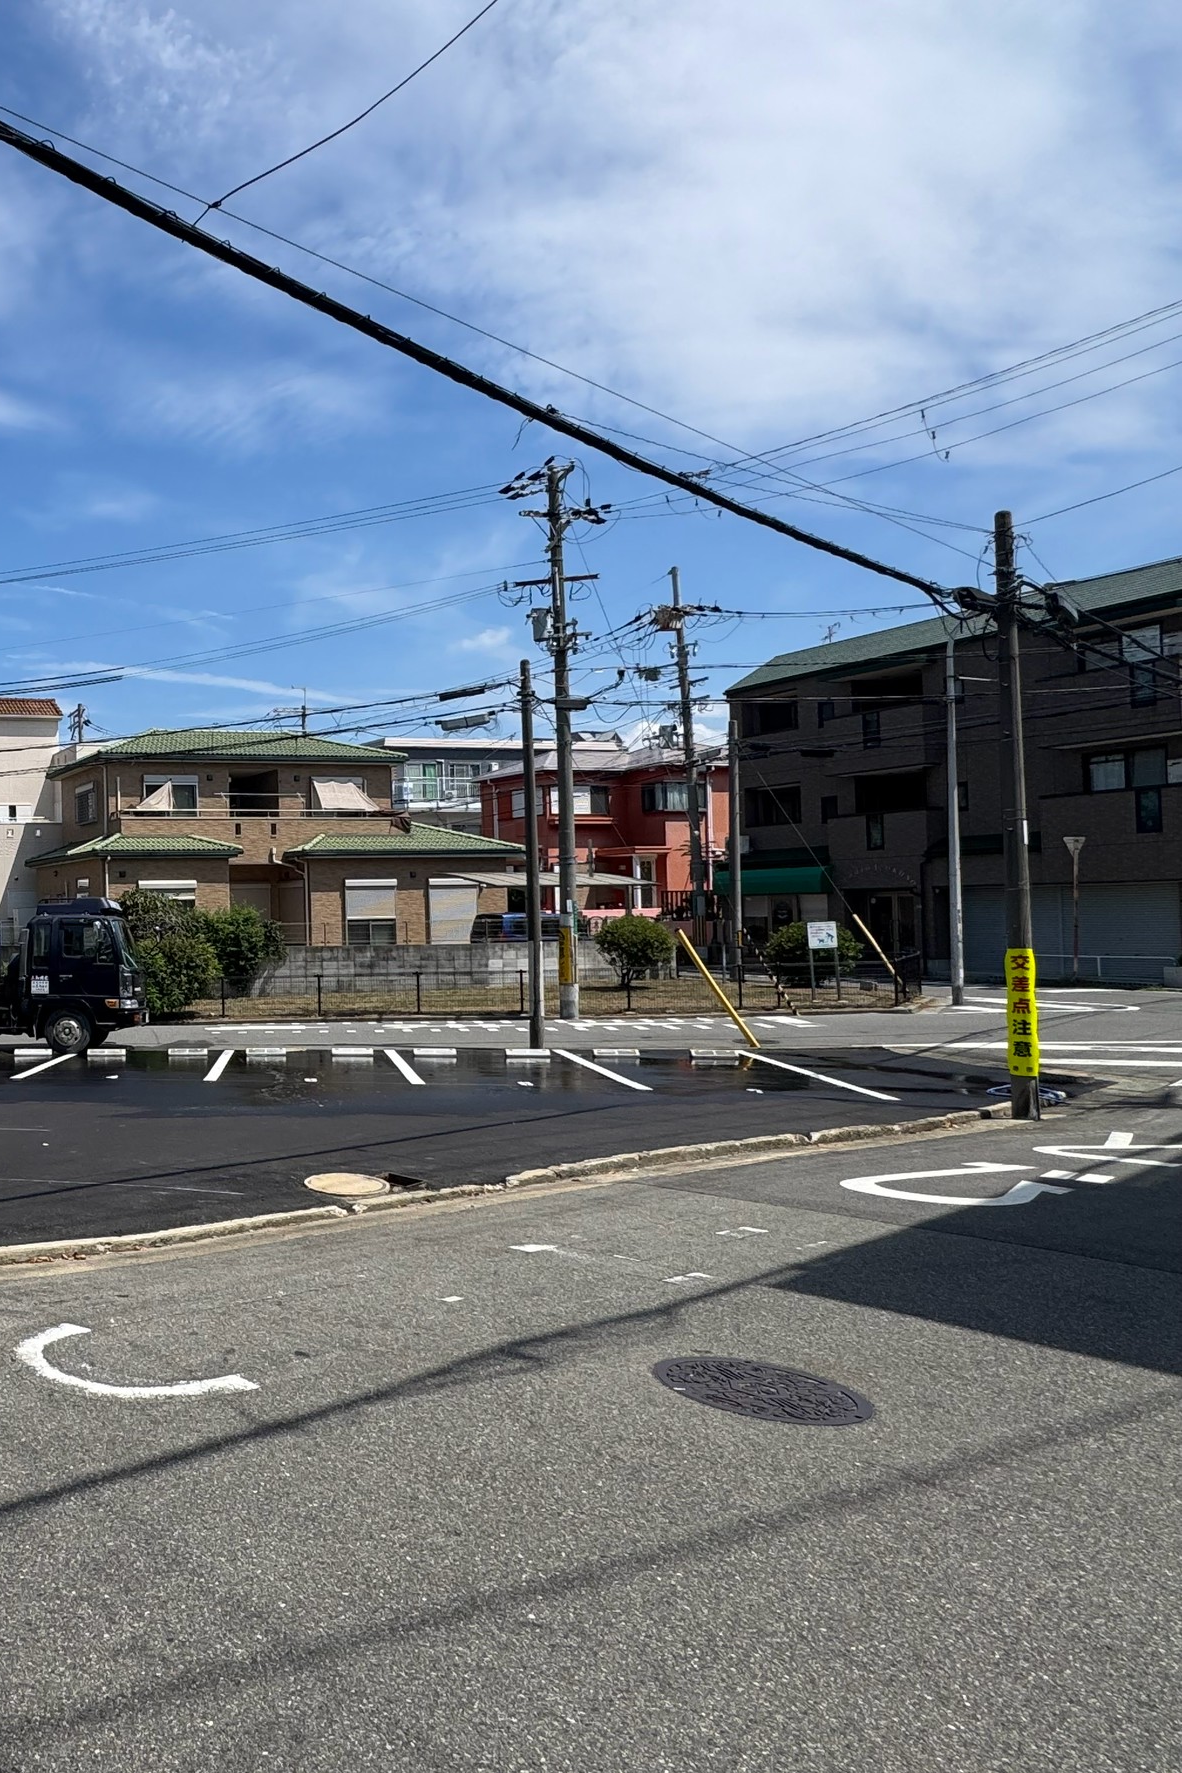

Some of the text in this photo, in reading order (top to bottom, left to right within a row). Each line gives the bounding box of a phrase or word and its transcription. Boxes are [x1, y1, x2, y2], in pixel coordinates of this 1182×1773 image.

[1010, 955, 1032, 1058] 交差点注意
